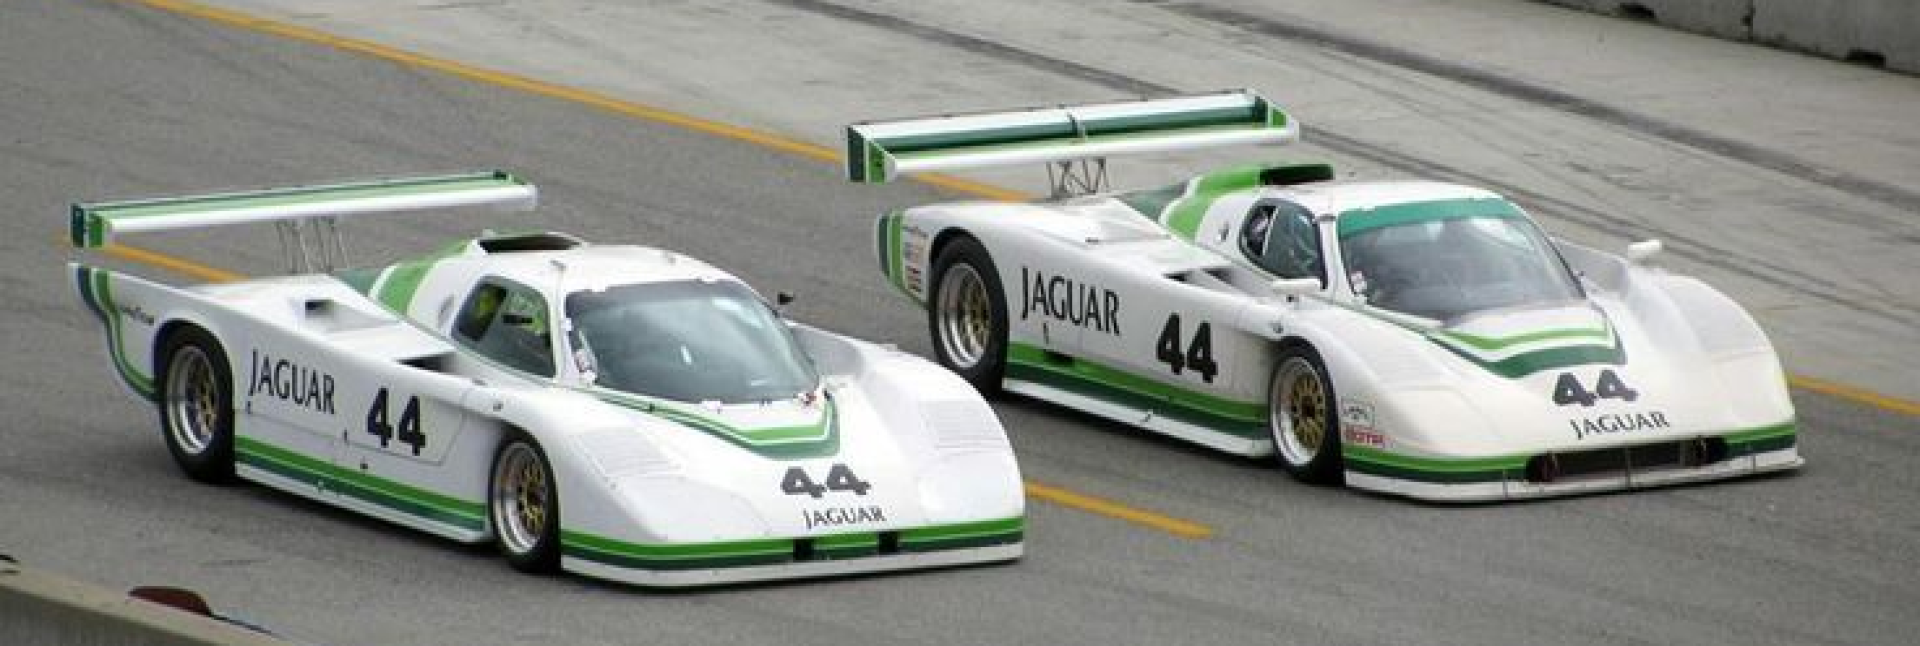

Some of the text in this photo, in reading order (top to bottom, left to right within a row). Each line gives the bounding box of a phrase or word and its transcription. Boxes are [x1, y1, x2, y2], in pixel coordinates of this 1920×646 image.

[1021, 266, 1120, 336] JAGUAR
[1156, 312, 1219, 384] 44
[248, 348, 335, 415] JAGUAR
[1552, 369, 1640, 407] 44
[367, 387, 426, 456] 44
[1570, 411, 1670, 440] JAGUAR
[780, 463, 871, 499] 44
[803, 505, 887, 530] JAGUAR
